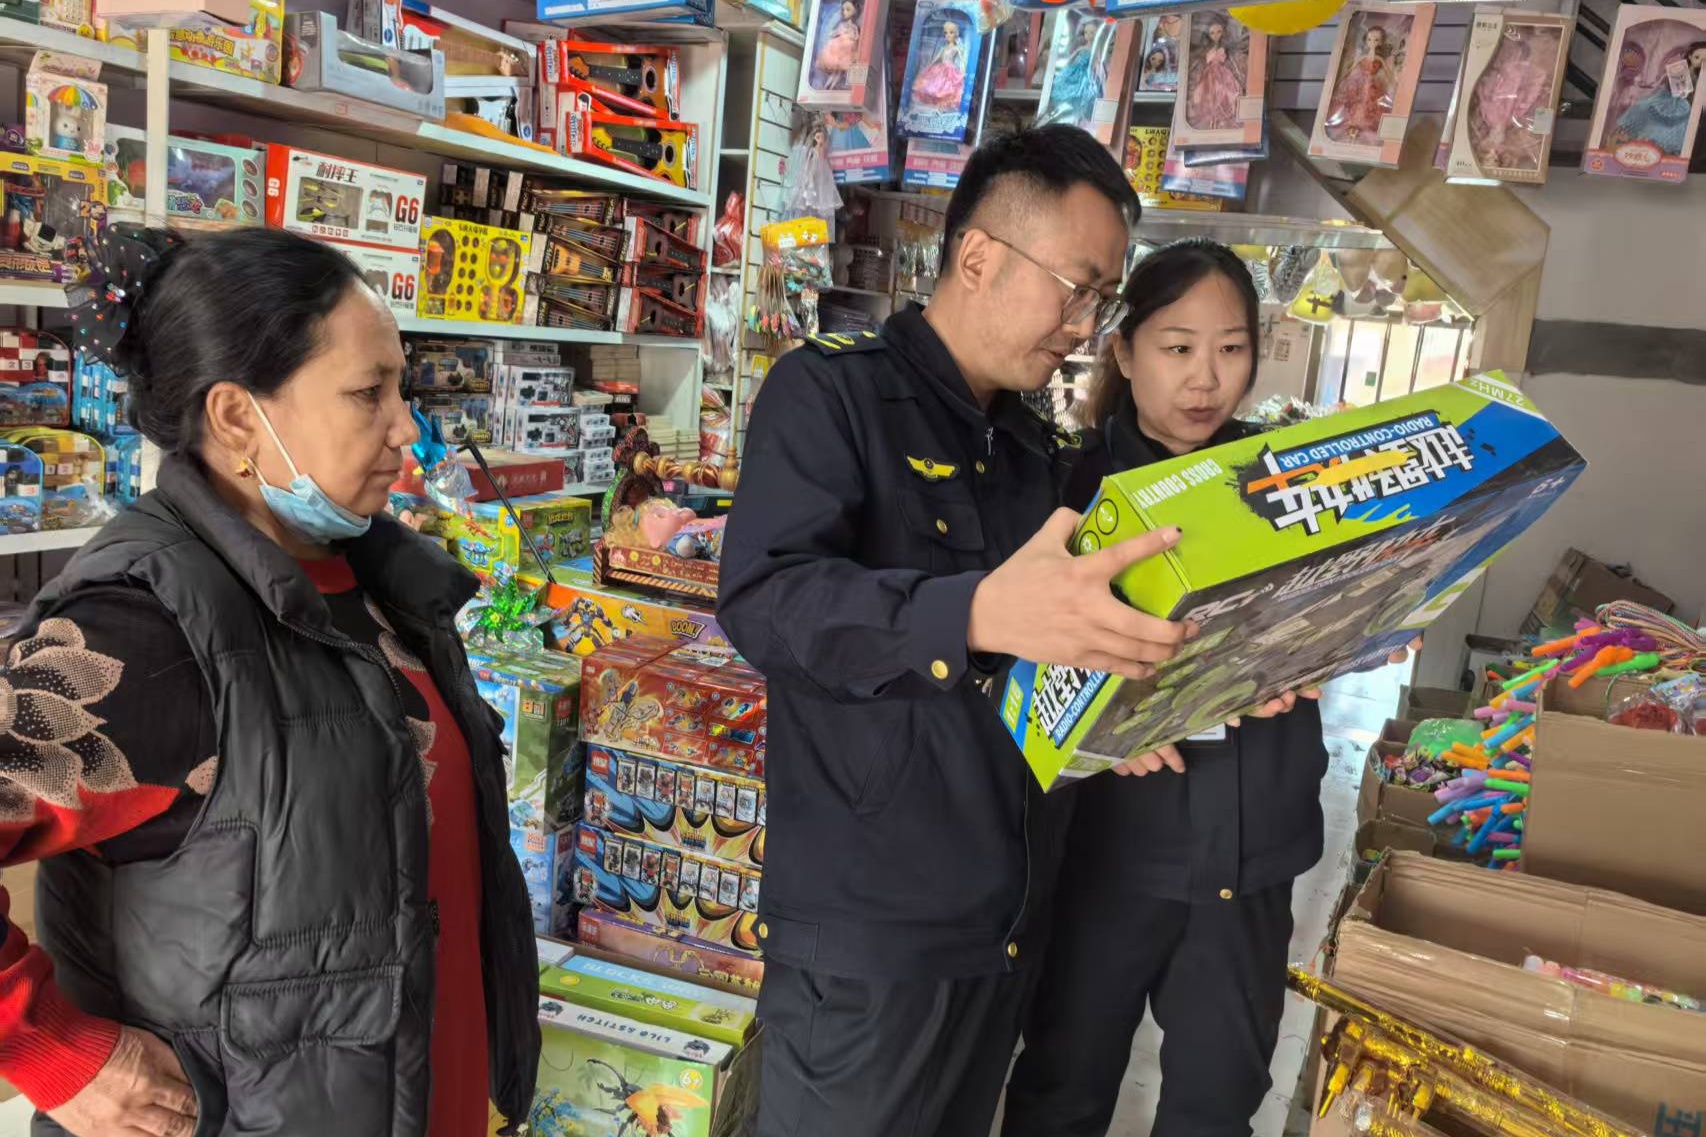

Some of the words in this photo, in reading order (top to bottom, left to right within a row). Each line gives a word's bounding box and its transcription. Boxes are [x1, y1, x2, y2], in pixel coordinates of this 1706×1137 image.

[394, 194, 420, 225] G6
[391, 271, 416, 301] G6
[1469, 379, 1526, 407] 27MHz
[1310, 415, 1434, 461] RADIO-CONTROLLED
[1181, 458, 1223, 487] CROSS
[1279, 453, 1310, 470] CAR
[1131, 474, 1188, 509] COUNTRY
